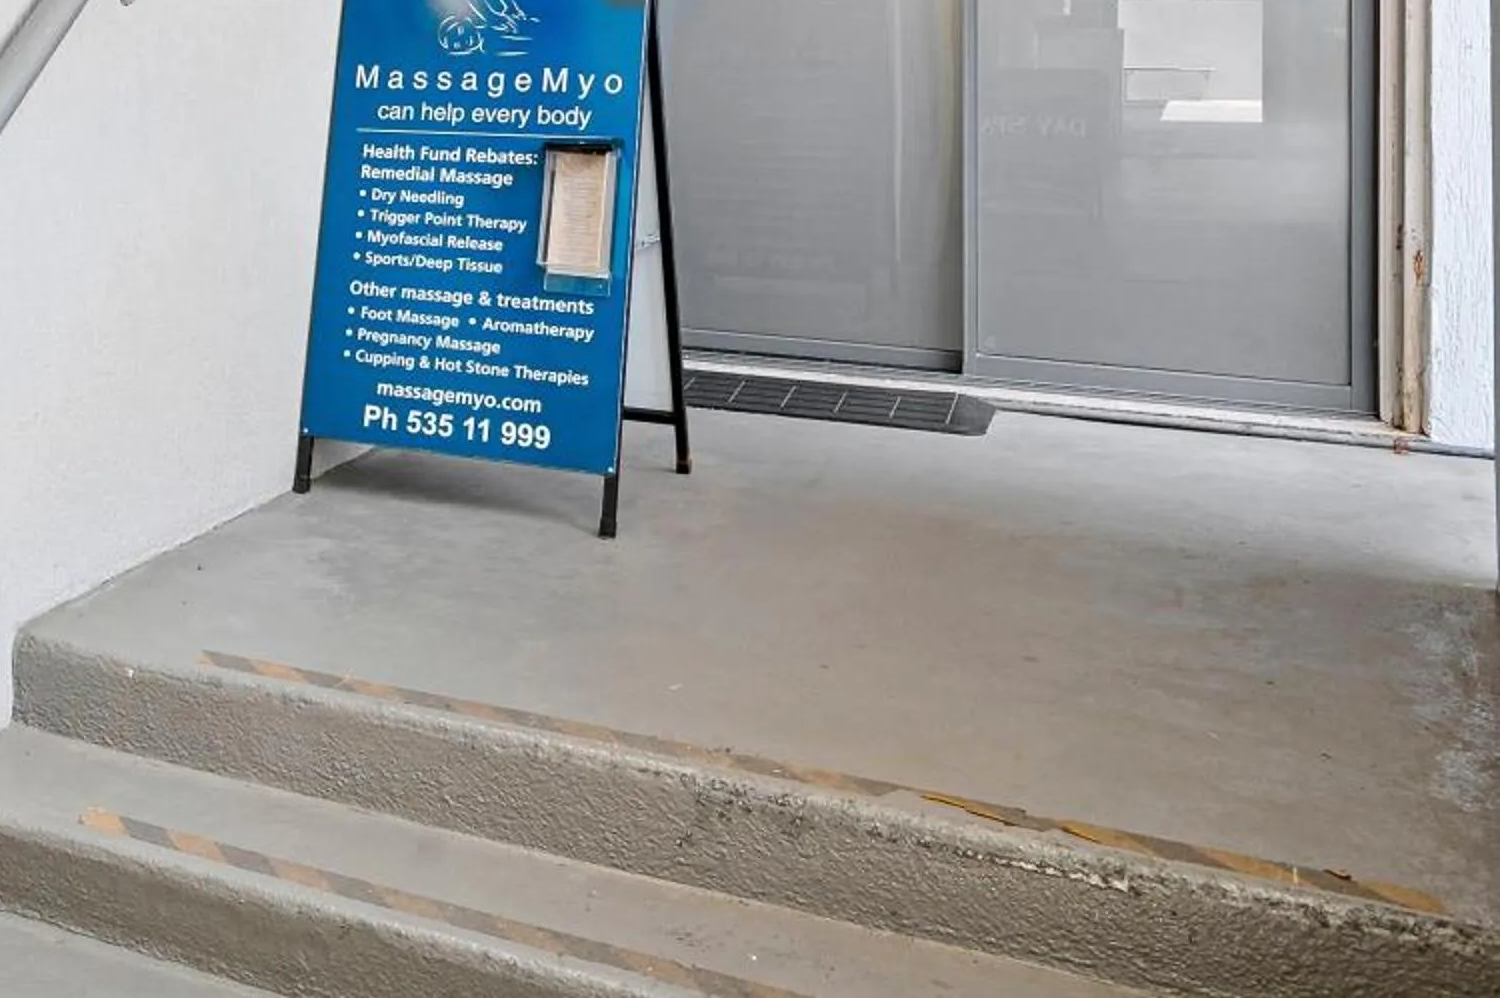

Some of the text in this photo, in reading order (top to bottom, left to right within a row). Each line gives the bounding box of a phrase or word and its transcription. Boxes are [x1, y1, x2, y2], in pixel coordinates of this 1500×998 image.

[356, 64, 623, 99] MassageMyo
[377, 103, 592, 130] can help every body
[363, 144, 539, 165] Health Fund Rebates:
[361, 164, 514, 188] Remedial Massage
[371, 188, 465, 208] Dry Needling
[370, 209, 527, 233] Trigger Point Therapy
[367, 230, 503, 251] Myofascial Release
[365, 251, 503, 273] Sports/Deep Tissue
[349, 280, 595, 315] Other massage & treatments
[361, 306, 595, 343] Foot Massage Aromatherapy
[357, 328, 501, 355] Pregnancy Massage
[355, 349, 589, 386] Cupping & Hot Stone Therapies
[377, 382, 542, 413] massagemyo.com
[363, 405, 551, 450] Ph 535 11 999
